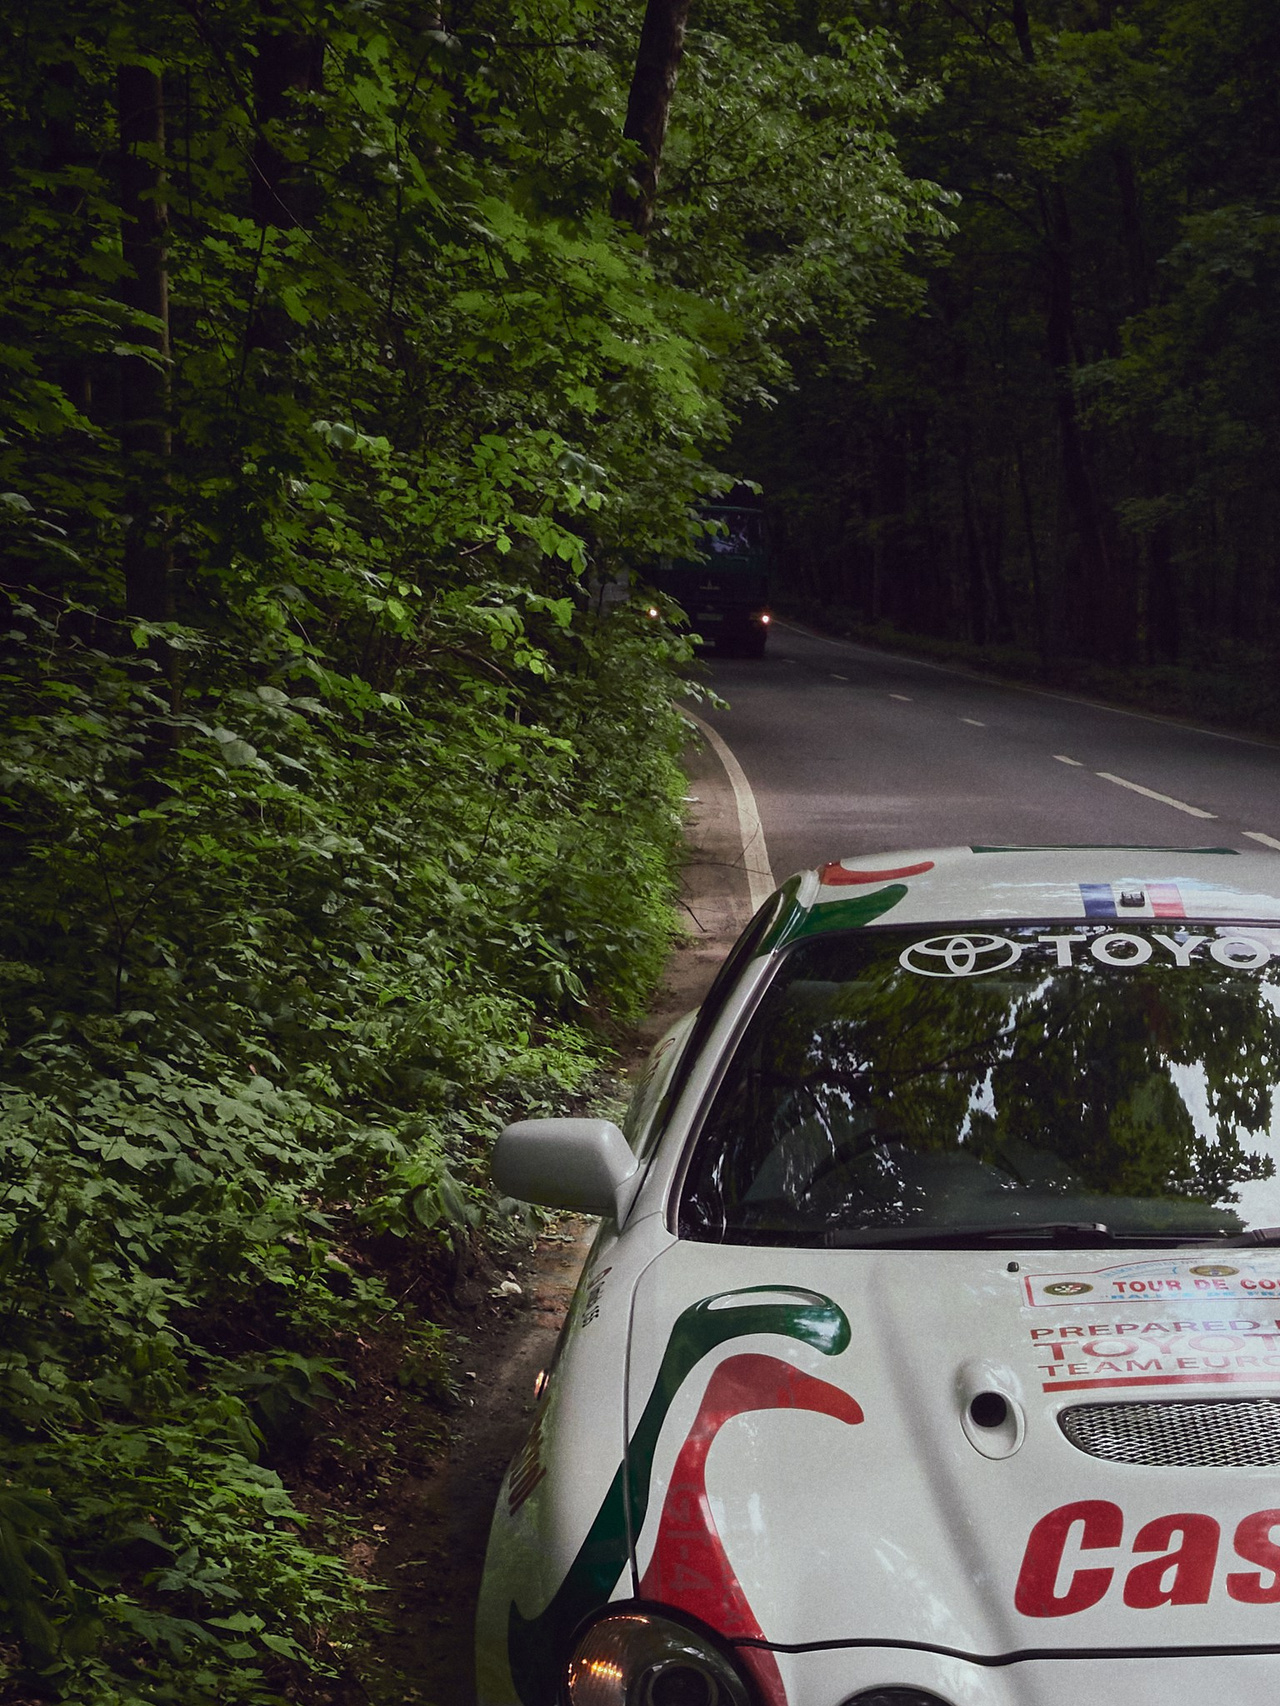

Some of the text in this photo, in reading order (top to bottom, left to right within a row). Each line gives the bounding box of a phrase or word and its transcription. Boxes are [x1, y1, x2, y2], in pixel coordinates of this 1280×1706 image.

[1112, 1280, 1183, 1293] TOUR
[1194, 1279, 1230, 1290] DE
[1031, 1319, 1260, 1340] PREPARED
[1038, 1357, 1162, 1377] TEAM
